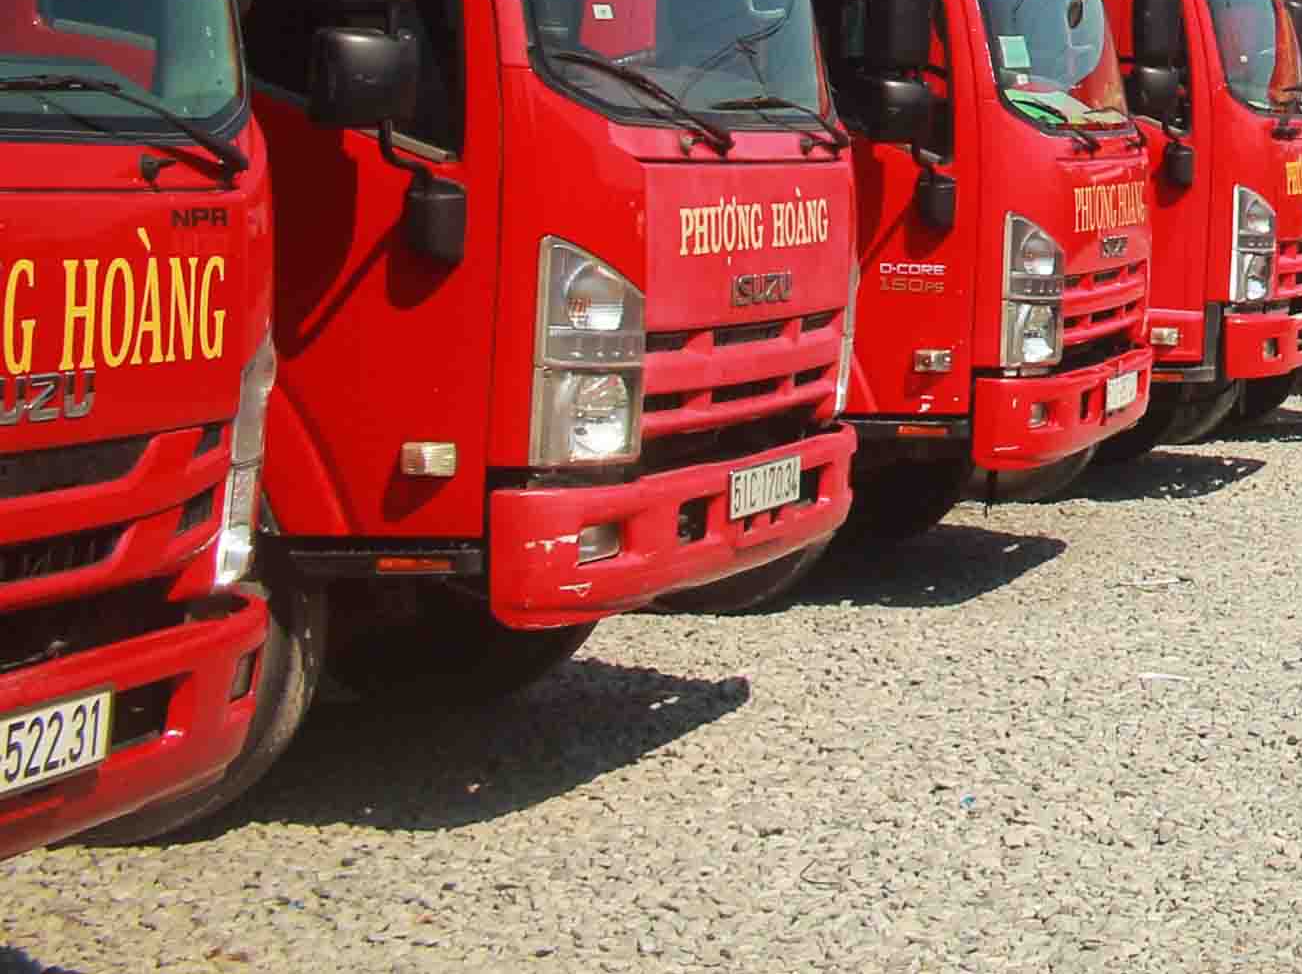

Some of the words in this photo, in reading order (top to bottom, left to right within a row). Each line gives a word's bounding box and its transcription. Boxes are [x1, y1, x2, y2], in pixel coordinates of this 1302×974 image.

[171, 208, 229, 227] NPR
[679, 195, 765, 267] PHƯỢNG
[771, 186, 829, 248] HOÀNG
[879, 262, 945, 275] D-CORE
[58, 226, 227, 372] HOÀNG
[730, 271, 793, 307] ISUZU
